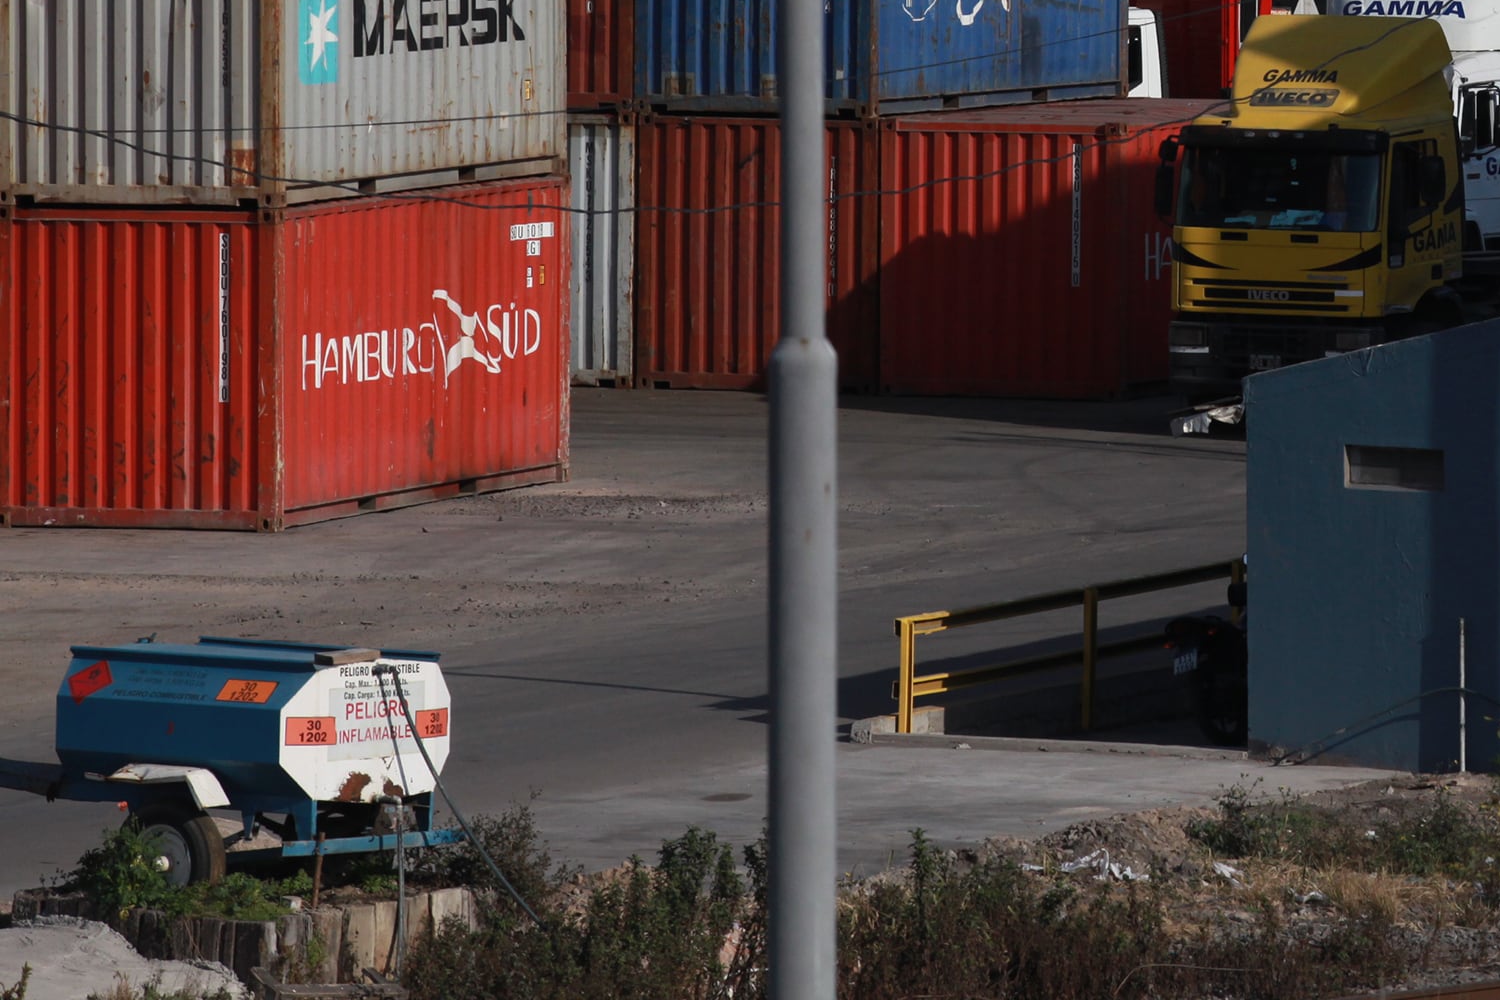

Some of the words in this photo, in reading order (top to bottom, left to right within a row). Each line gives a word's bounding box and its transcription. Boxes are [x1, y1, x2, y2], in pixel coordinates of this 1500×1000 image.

[1343, 0, 1466, 19] GAMMA
[1262, 68, 1340, 83] GAMMA
[1254, 90, 1329, 106] IVECO
[221, 234, 229, 290] SUDU
[1247, 288, 1290, 301] IVECO
[221, 295, 229, 381] 760198
[221, 385, 229, 400] 0
[340, 666, 369, 677] PELIGRO
[241, 682, 258, 691] 30
[229, 691, 259, 701] 1202
[345, 699, 409, 721] PELIGRO
[430, 712, 440, 724] 30
[306, 720, 322, 731] 30
[425, 724, 443, 736] 1202
[299, 732, 327, 743] 1202
[338, 723, 412, 745] INFLAMABLE
